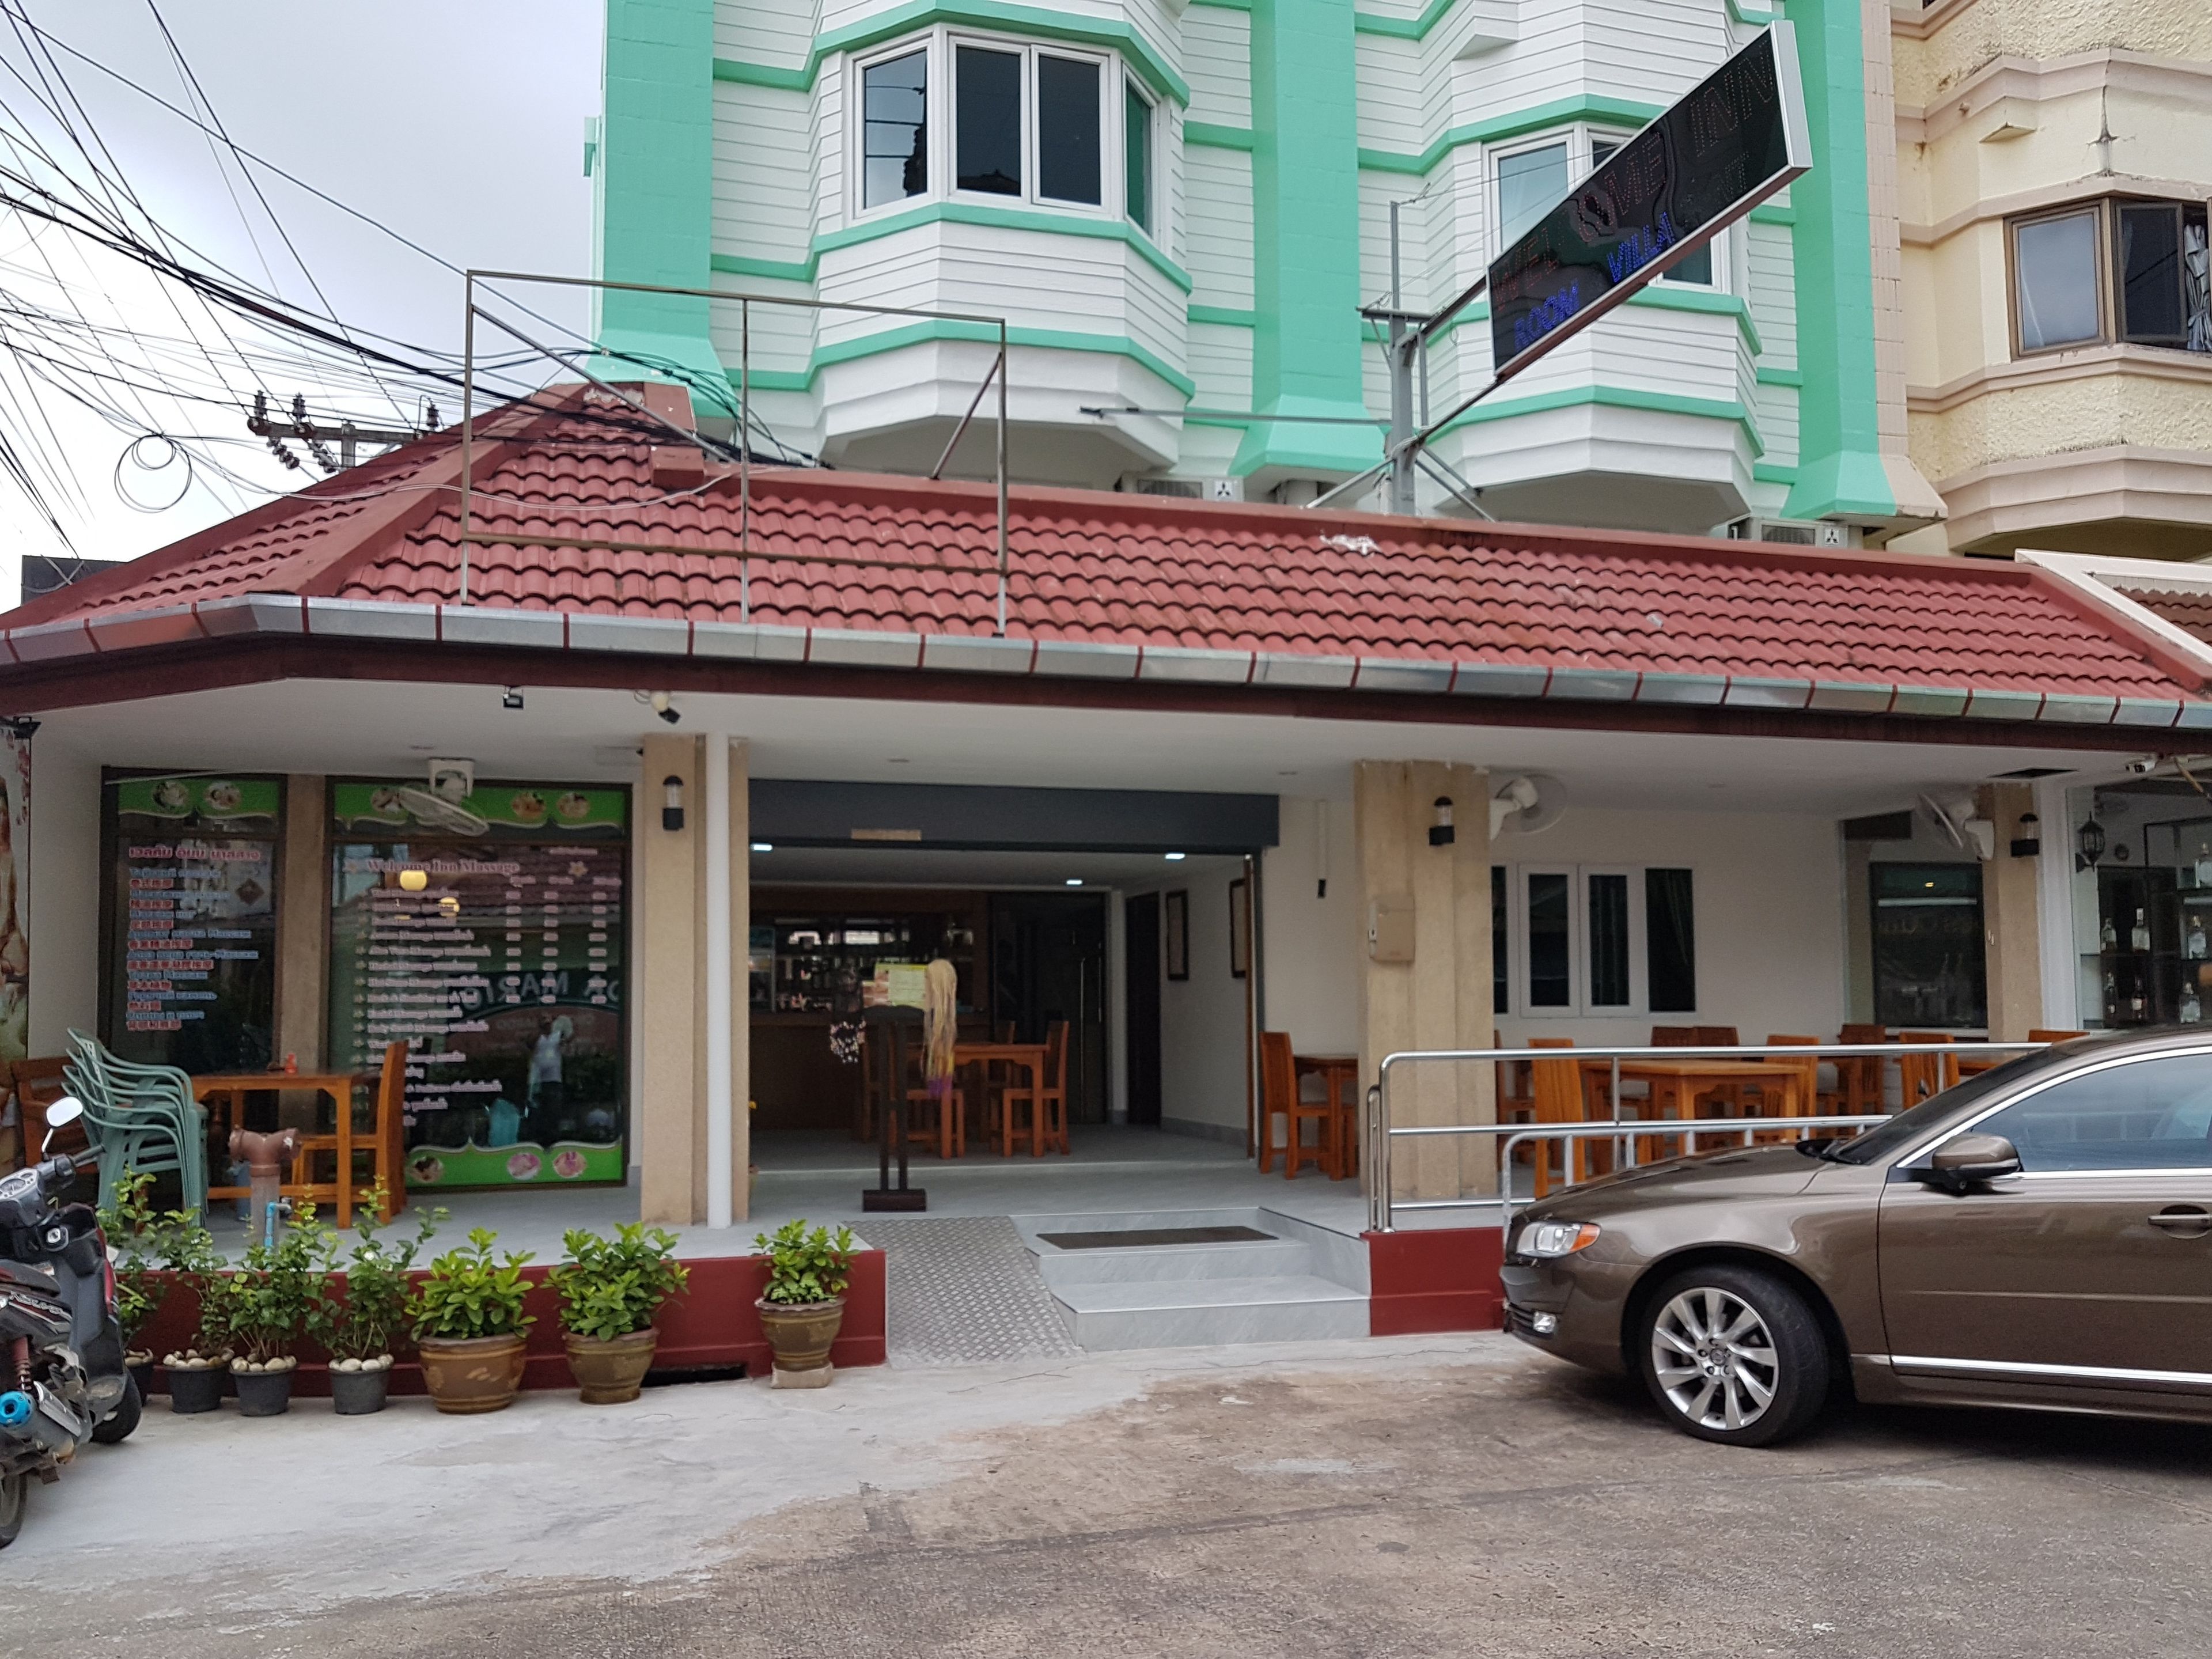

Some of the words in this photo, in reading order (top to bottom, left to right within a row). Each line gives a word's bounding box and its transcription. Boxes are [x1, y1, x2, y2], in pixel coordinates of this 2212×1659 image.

[1688, 39, 1774, 157] INN
[1514, 279, 1580, 351] ROOM
[1607, 211, 1677, 283] VILLA
[460, 858, 520, 875] Massage
